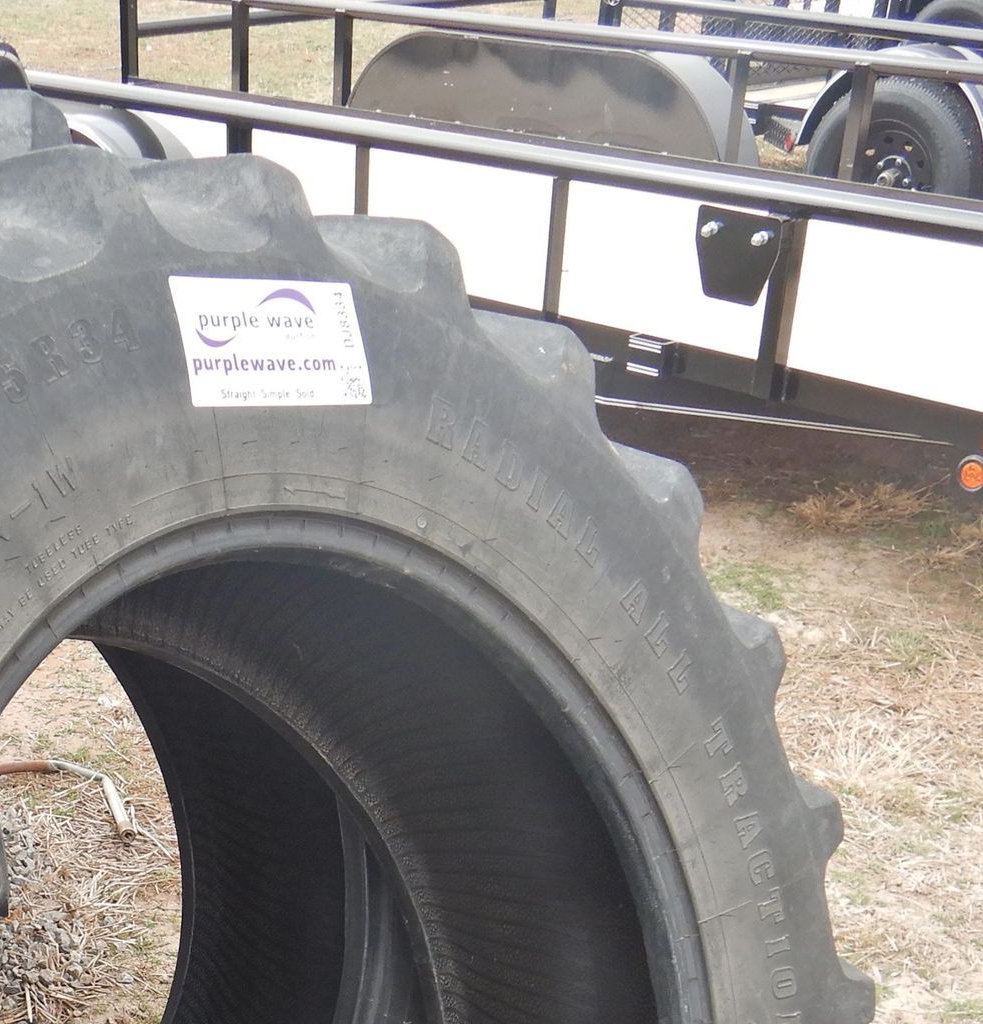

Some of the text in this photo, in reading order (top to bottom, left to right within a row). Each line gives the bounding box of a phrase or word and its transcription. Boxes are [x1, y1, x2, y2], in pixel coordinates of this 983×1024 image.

[198, 311, 315, 331] purple wave
[192, 353, 337, 376] purplewave.com
[425, 394, 600, 568] RADIAL
[619, 577, 695, 696] ALL
